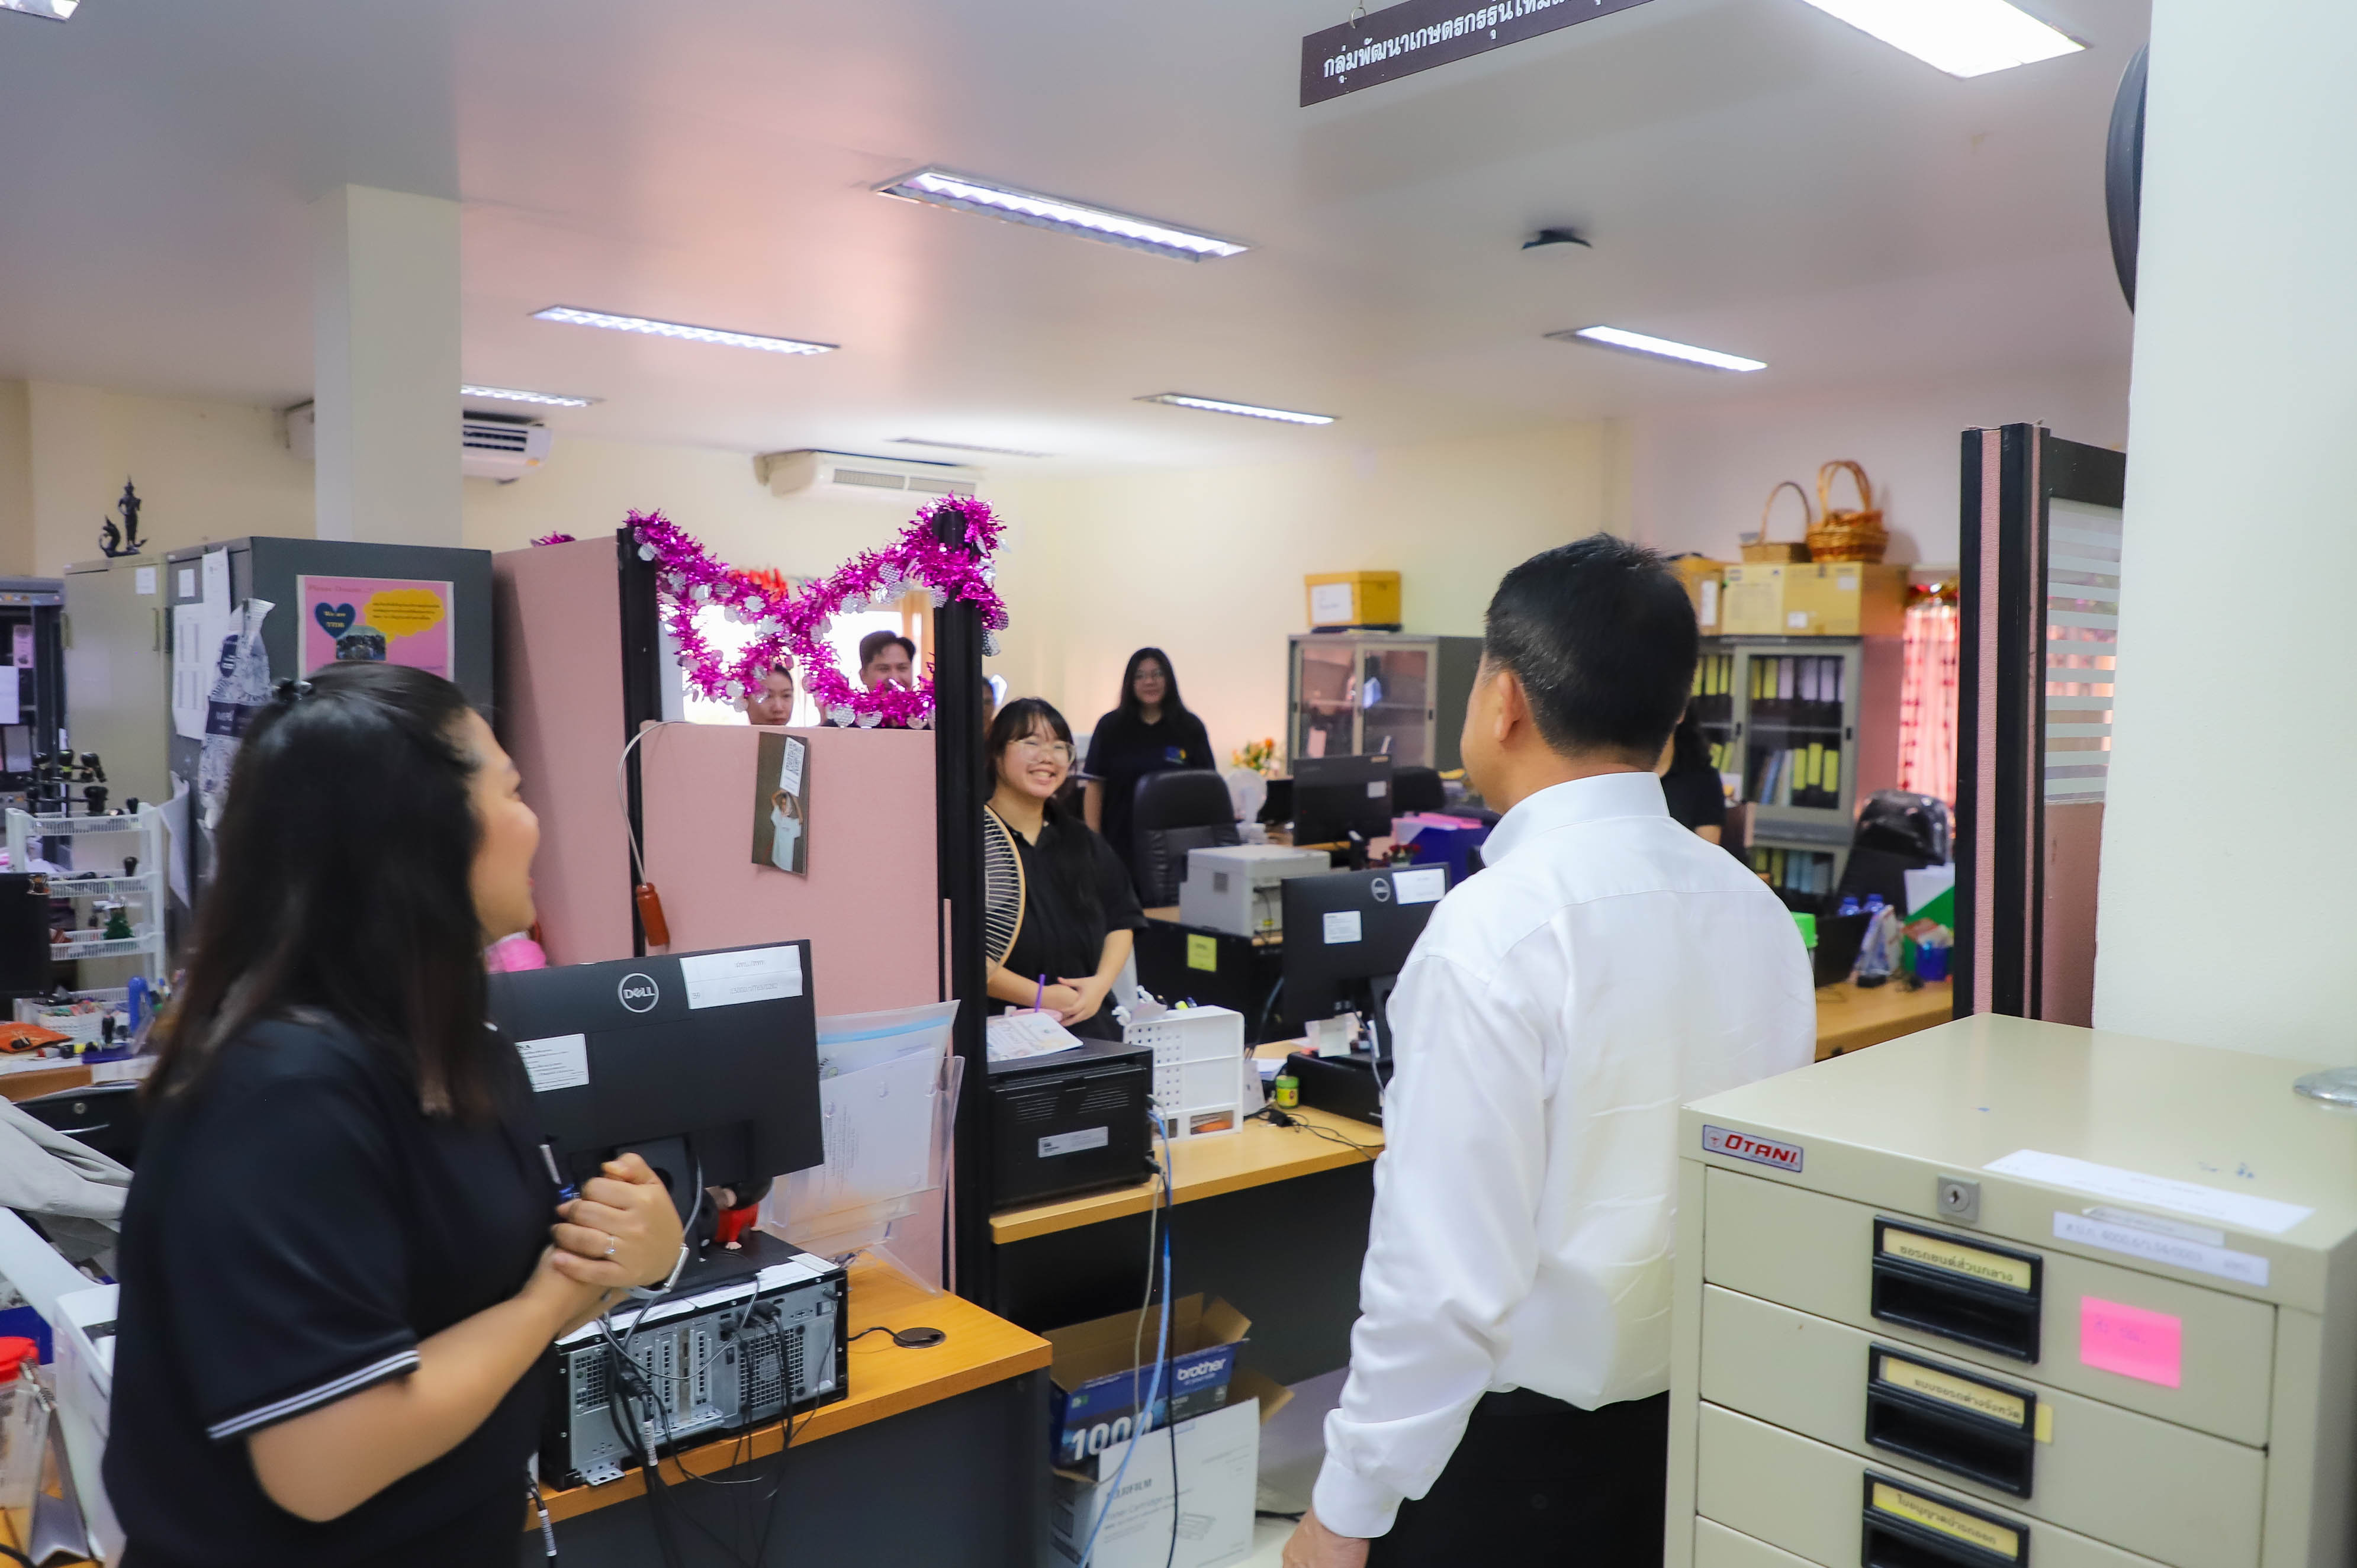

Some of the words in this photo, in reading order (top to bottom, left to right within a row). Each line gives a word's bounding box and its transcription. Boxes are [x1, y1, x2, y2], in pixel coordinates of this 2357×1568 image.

[623, 986, 656, 999] DELL
[1724, 1134, 1798, 1163] OTANI
[1177, 1358, 1227, 1381] brother
